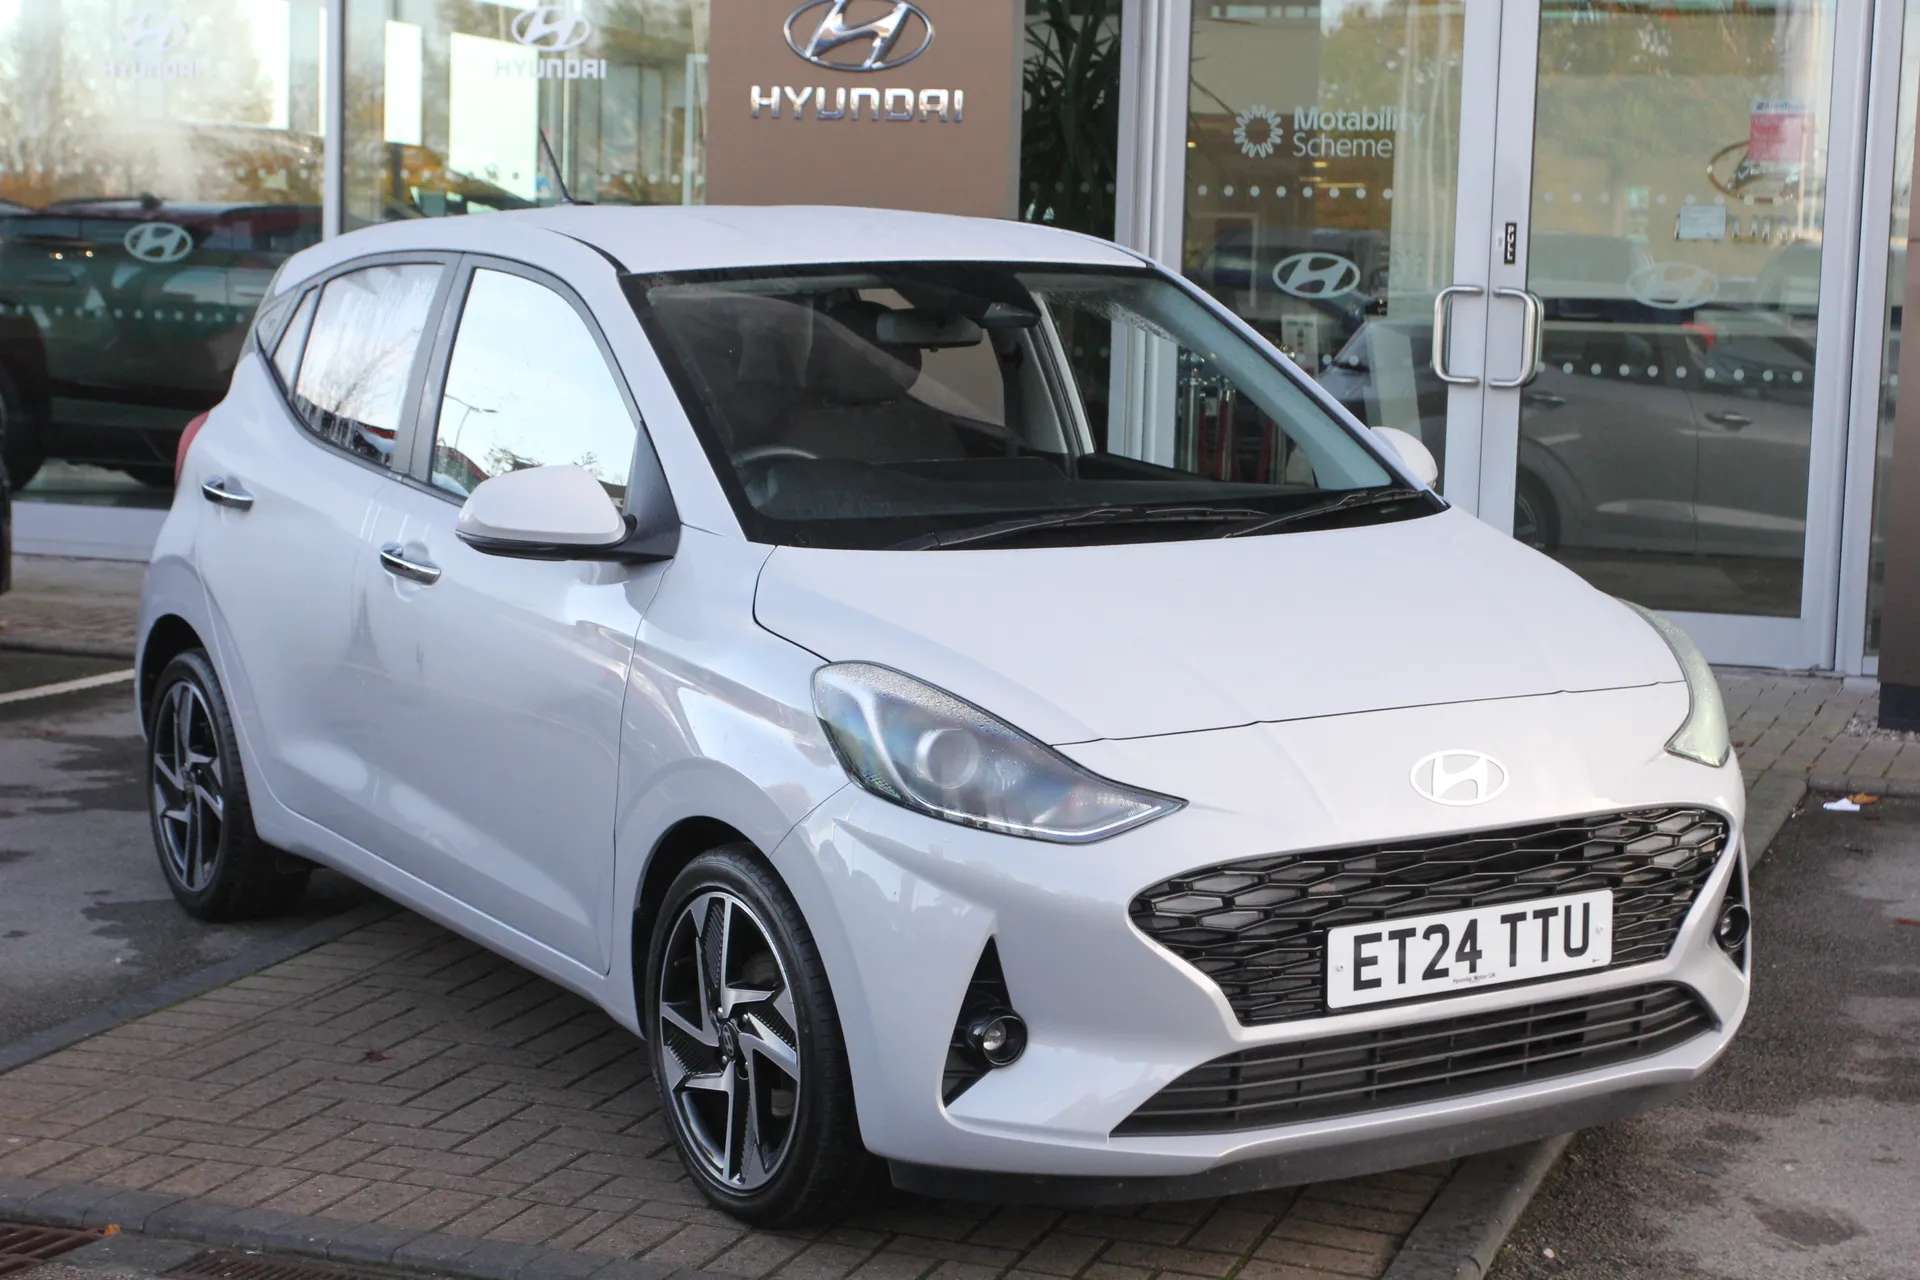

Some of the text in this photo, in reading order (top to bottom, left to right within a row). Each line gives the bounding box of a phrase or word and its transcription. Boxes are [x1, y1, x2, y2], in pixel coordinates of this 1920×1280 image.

[496, 58, 608, 79] HYUNDAI
[751, 85, 964, 122] HYUNDAI
[1293, 104, 1425, 144] Motability
[1293, 131, 1393, 157] Scheme
[1353, 902, 1590, 992] ET24 TTU
